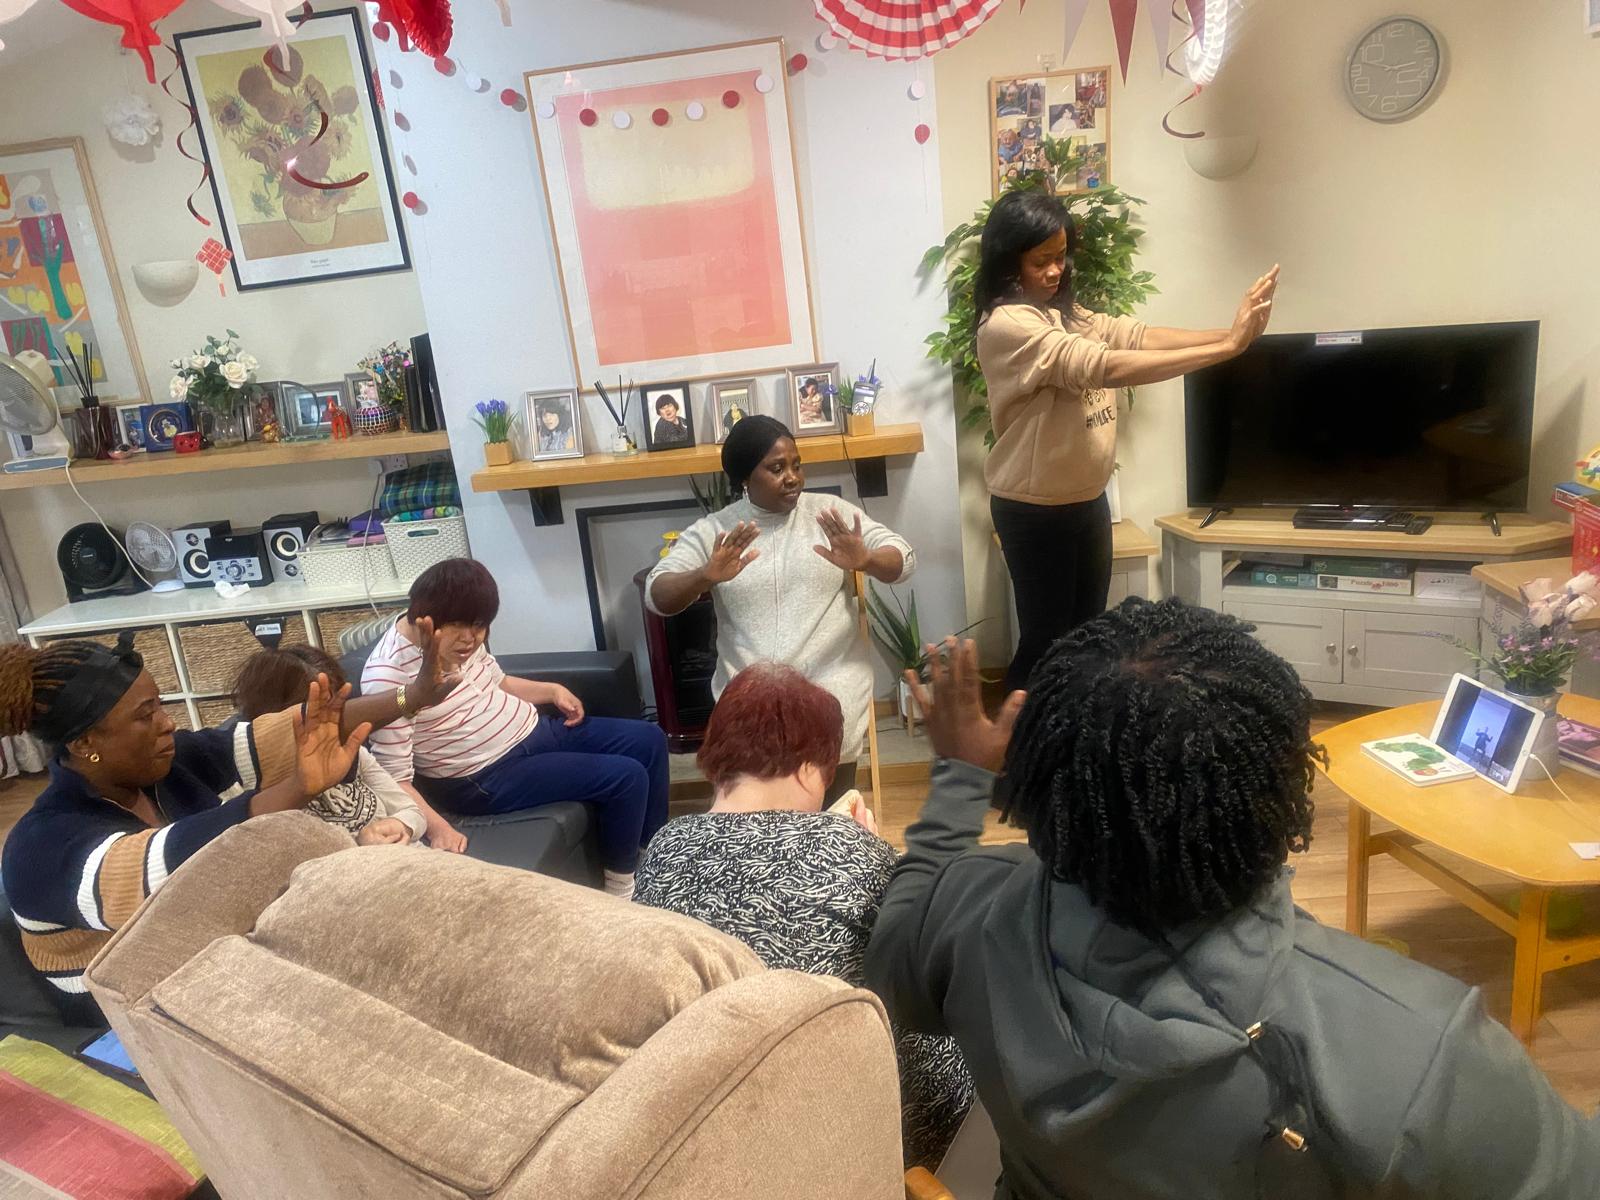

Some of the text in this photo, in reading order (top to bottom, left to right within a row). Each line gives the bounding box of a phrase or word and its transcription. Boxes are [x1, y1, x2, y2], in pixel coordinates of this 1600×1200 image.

[1386, 23, 1406, 38] 12
[1360, 44, 1385, 63] 10
[1415, 39, 1431, 54] 2
[1352, 77, 1369, 94] 8
[1396, 68, 1422, 98] 5
[1367, 94, 1378, 108] 7
[1381, 95, 1398, 113] 6
